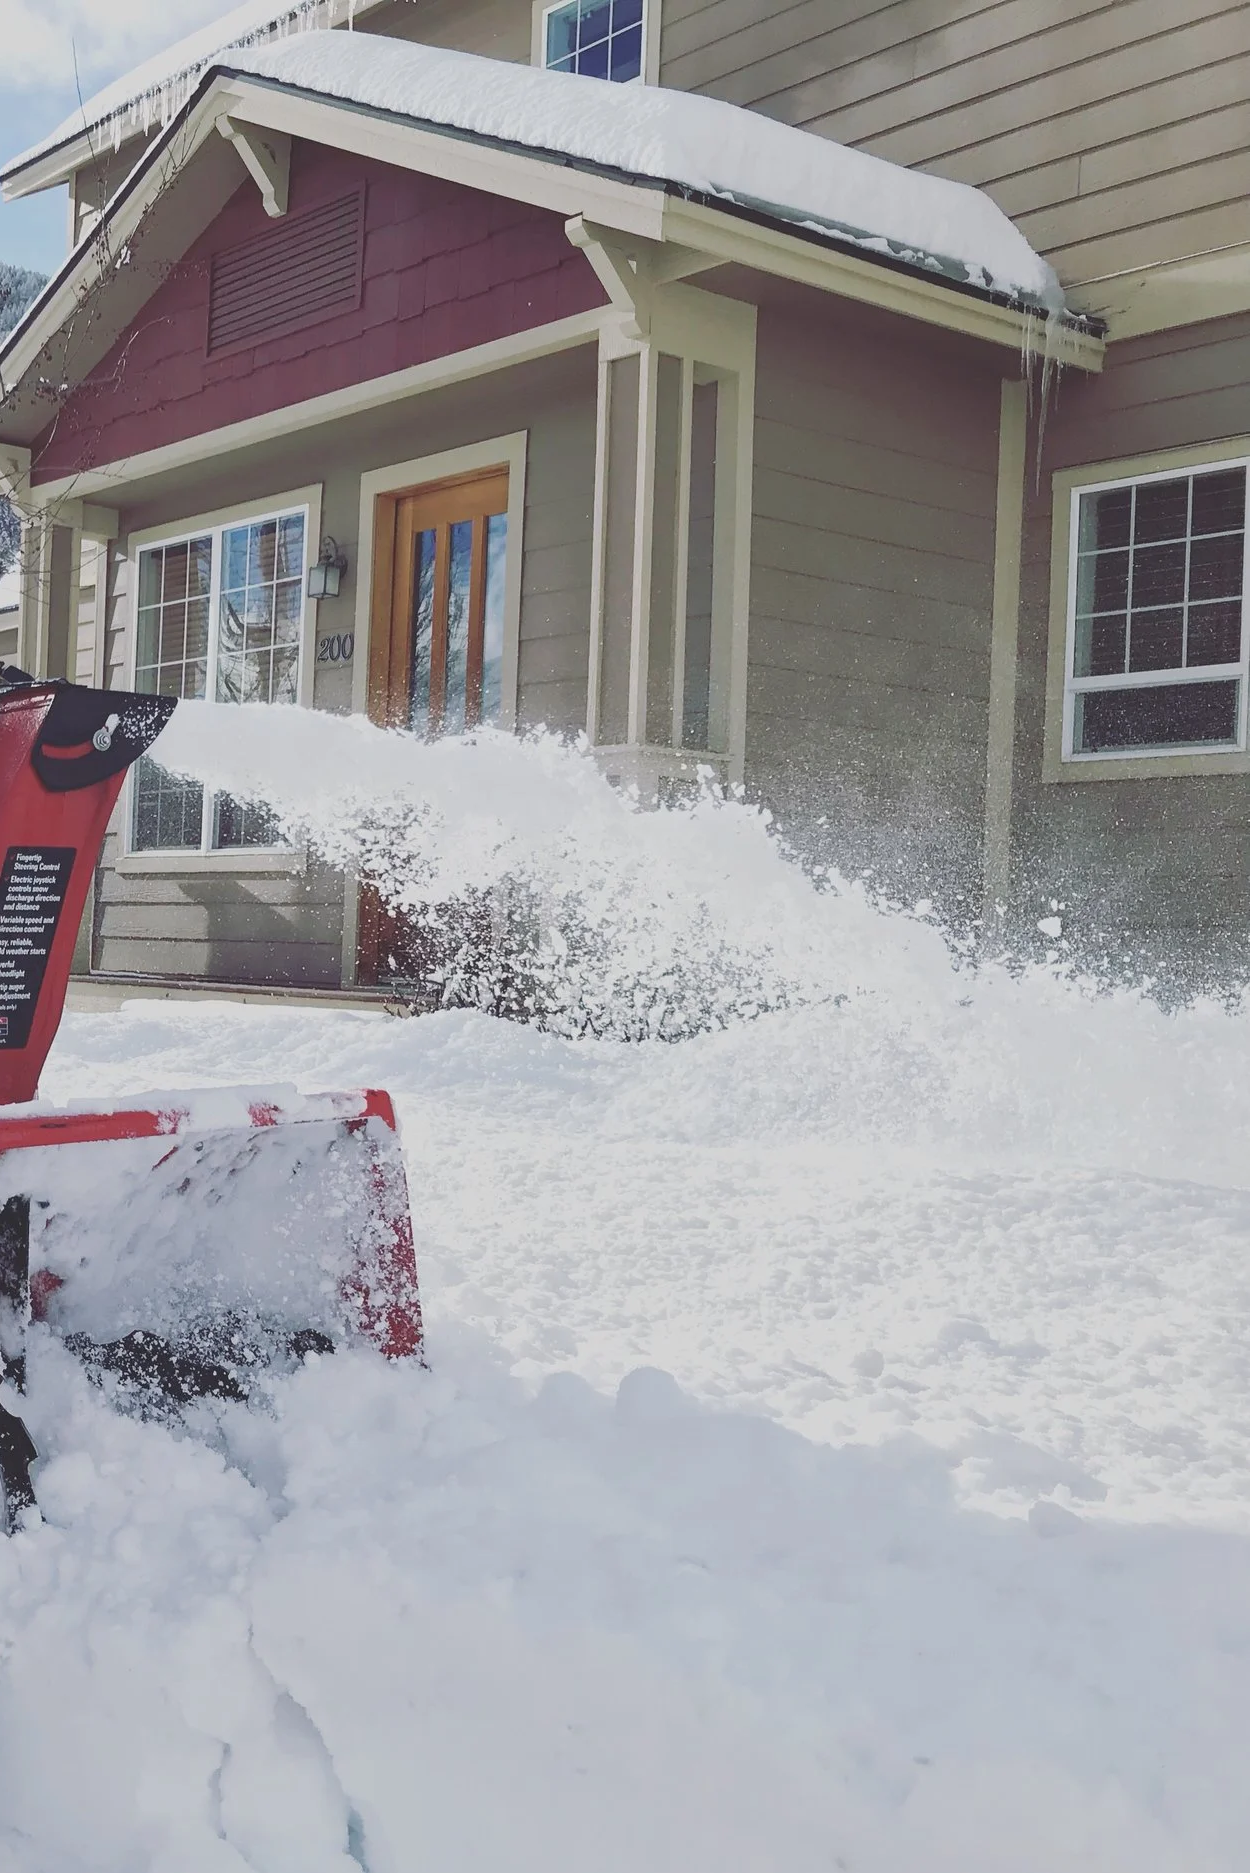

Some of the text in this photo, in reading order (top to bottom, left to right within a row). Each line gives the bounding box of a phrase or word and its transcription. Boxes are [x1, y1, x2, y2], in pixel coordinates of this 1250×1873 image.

[317, 634, 354, 662] 200
[16, 853, 42, 863] Fingertip
[14, 862, 60, 872] Steering Control
[10, 875, 56, 885] Electric joystick
[5, 893, 60, 903] discharge direction
[15, 903, 40, 911] distance
[0, 916, 54, 925] Variable speed and
[24, 925, 44, 933] control
[10, 938, 33, 947] reliable,
[5, 947, 29, 955] weather
[8, 984, 25, 992] auger
[0, 992, 30, 1001] adjustment
